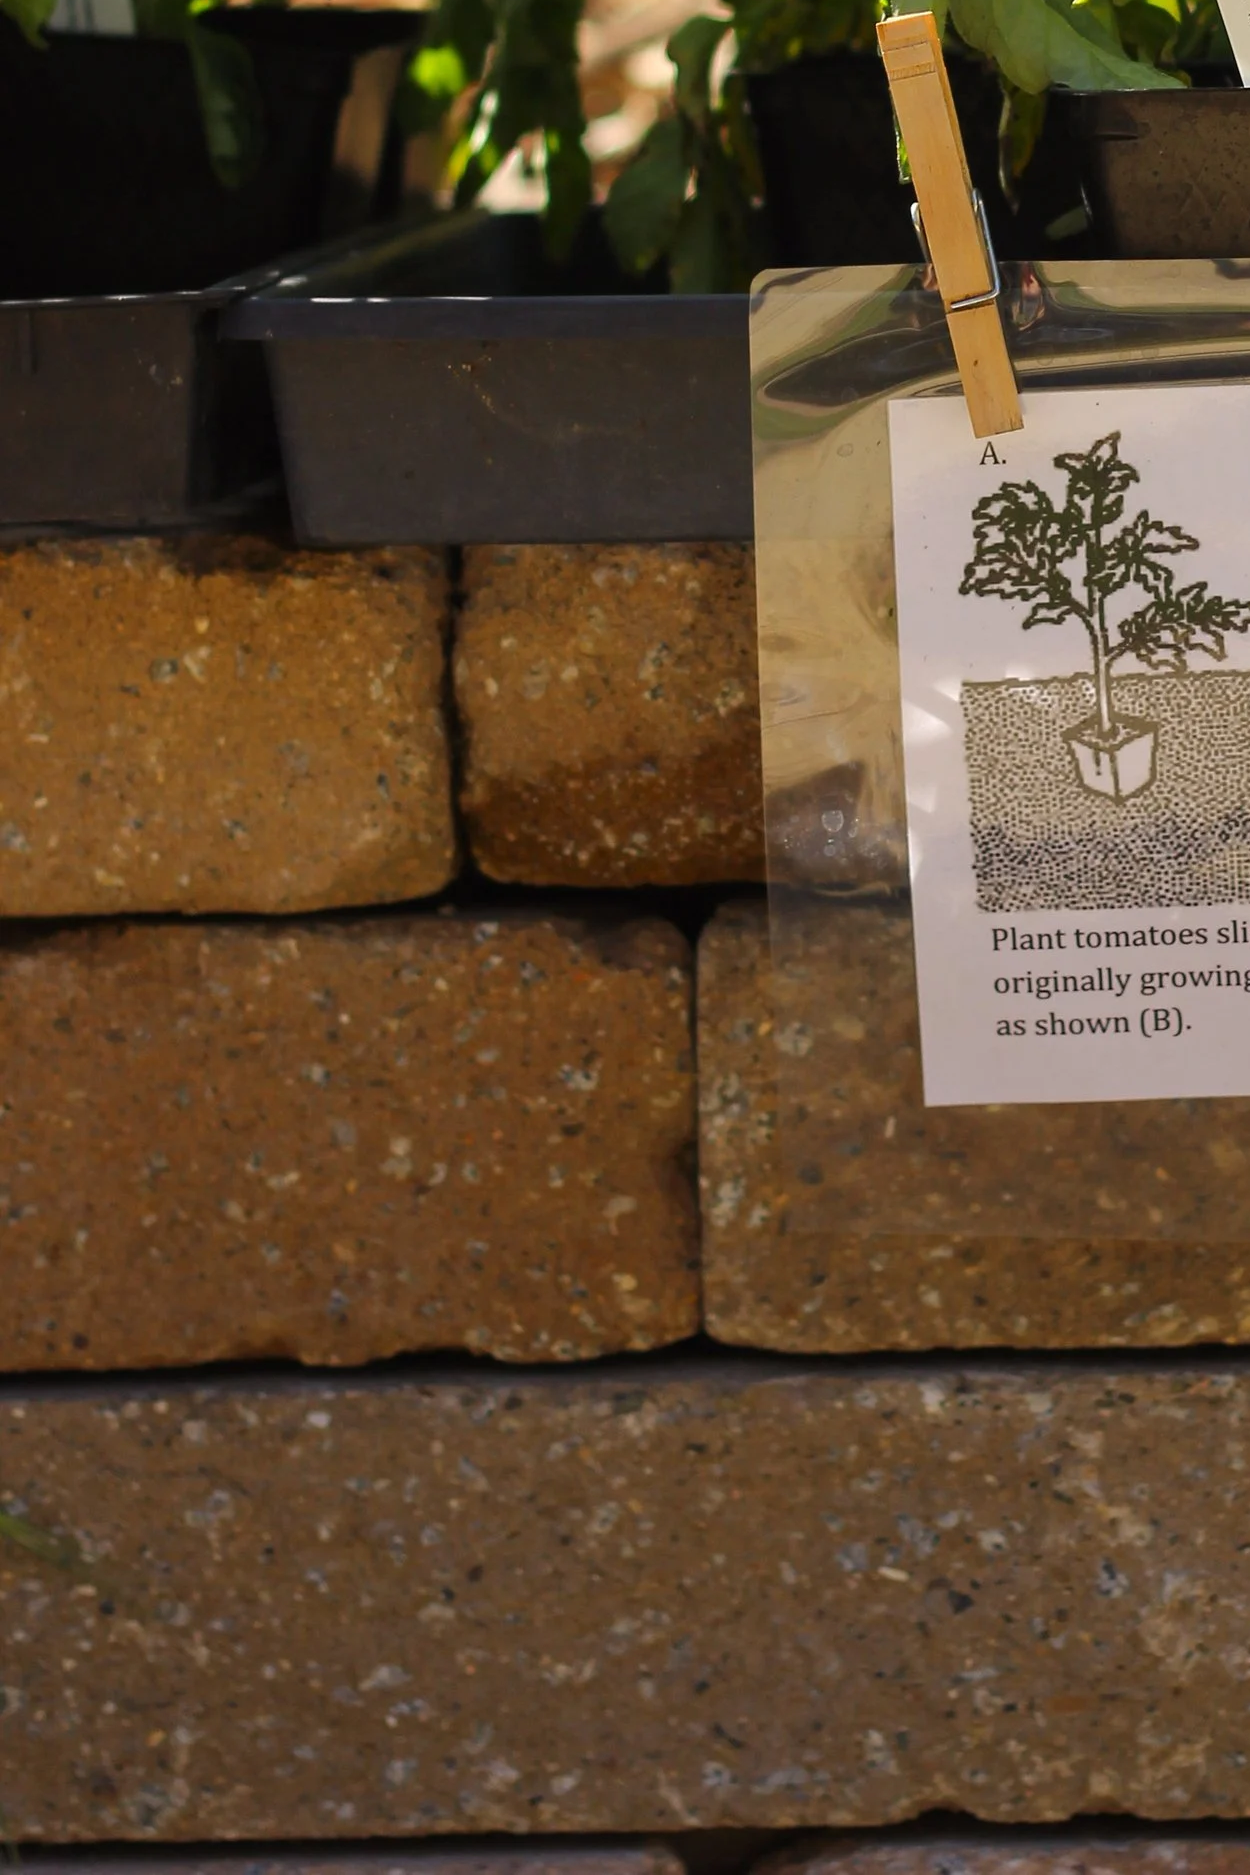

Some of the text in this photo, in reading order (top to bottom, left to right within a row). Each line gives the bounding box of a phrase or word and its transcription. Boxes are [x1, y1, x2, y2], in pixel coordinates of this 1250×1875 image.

[979, 441, 1007, 465] A.
[991, 927, 1067, 951] Plant
[1074, 925, 1208, 949] tomatoes
[993, 967, 1131, 999] originally
[996, 1007, 1192, 1038] as shown (B).
